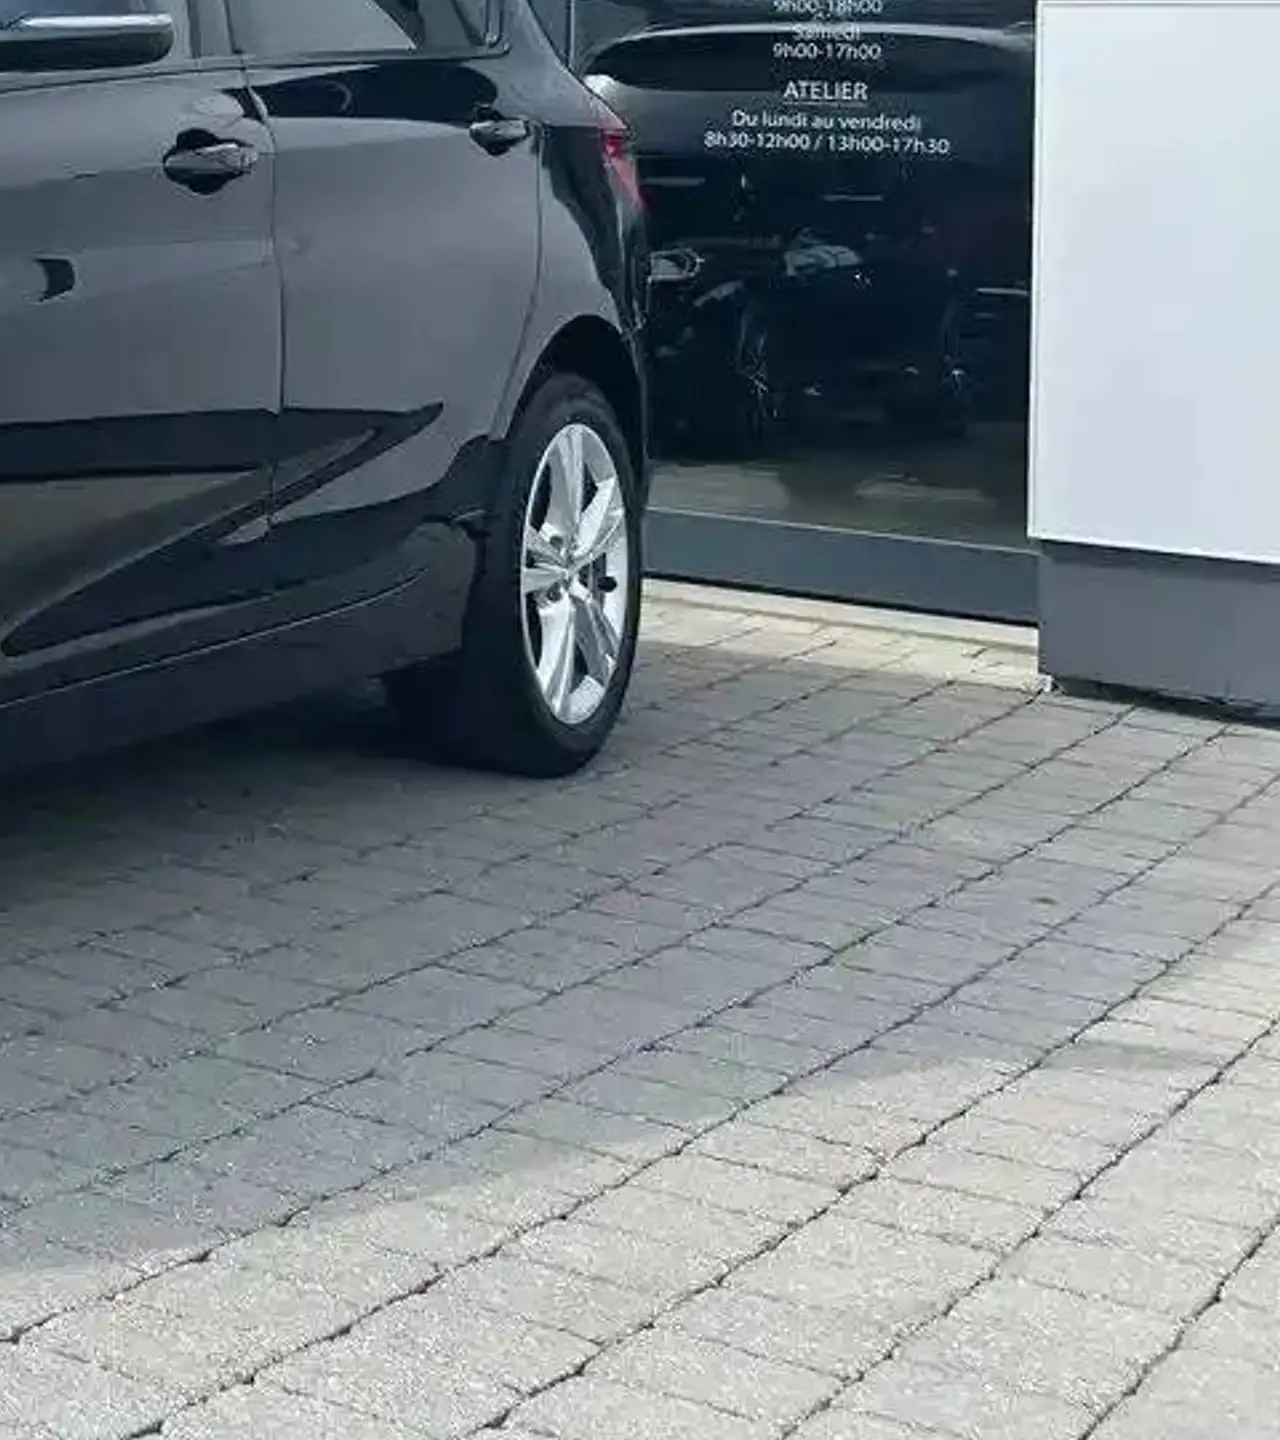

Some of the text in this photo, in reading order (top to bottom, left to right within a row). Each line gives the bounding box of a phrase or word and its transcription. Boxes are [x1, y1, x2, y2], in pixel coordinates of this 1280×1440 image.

[772, 41, 882, 60] 9h00-17h00
[783, 80, 868, 101] ATELIER
[732, 110, 922, 134] Du lundi au vendredi
[703, 131, 811, 149] 8h30-12h00
[828, 134, 951, 154] 13h00-17h30
